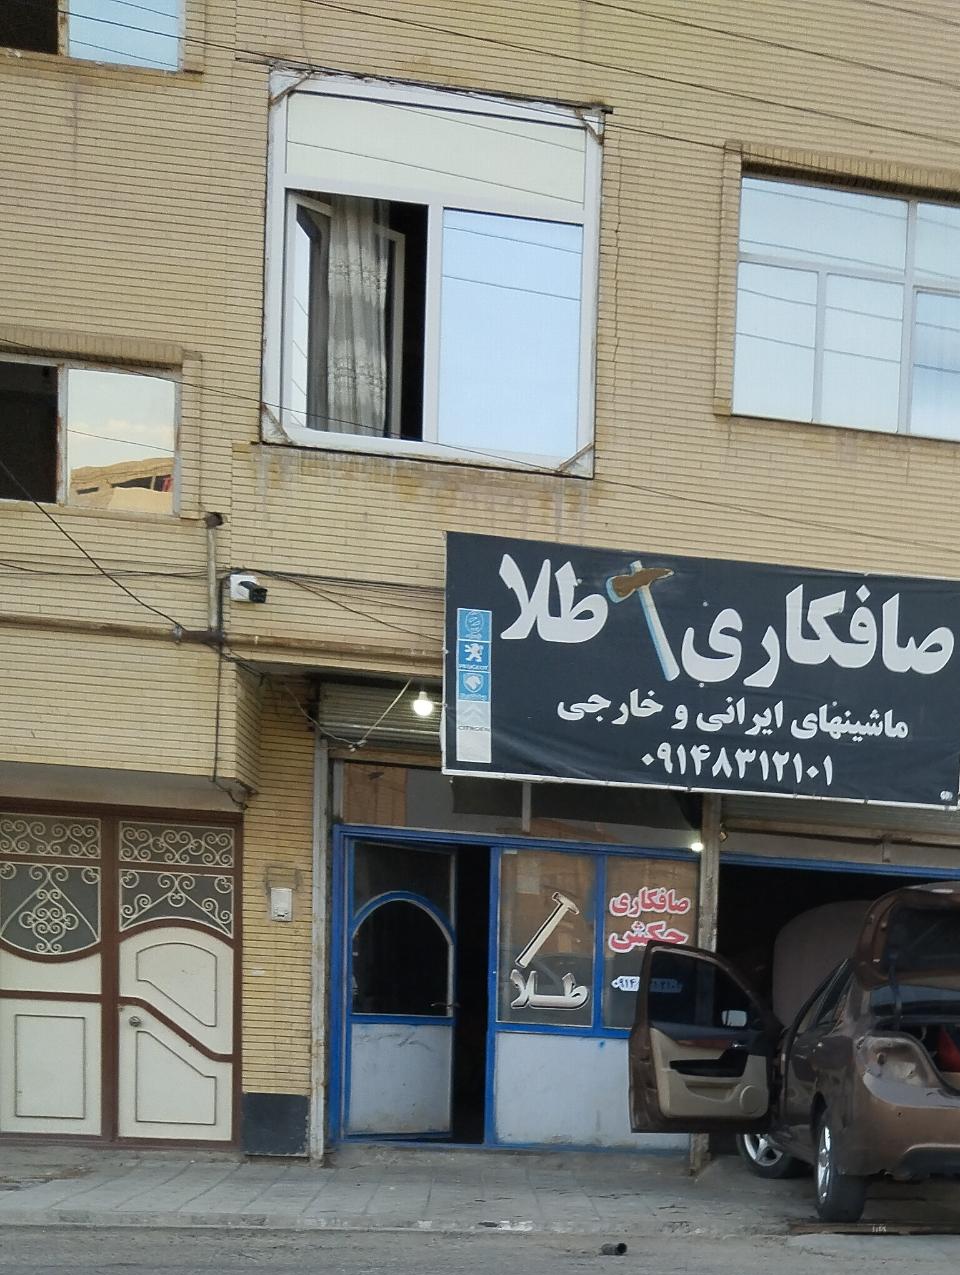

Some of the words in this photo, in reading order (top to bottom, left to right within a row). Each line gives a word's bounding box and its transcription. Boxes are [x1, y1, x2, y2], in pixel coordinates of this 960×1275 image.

[499, 554, 608, 644] طلا
[681, 583, 955, 688] صافکاری
[557, 688, 664, 726] خارجی
[673, 703, 689, 730] و
[697, 700, 784, 738] ایرانی
[790, 702, 909, 742] ماشینهای
[642, 741, 833, 786] ۰۹۱۴۸۳۱۲۱۰۱
[609, 886, 691, 918] صافکاری
[510, 969, 590, 1010] طلا
